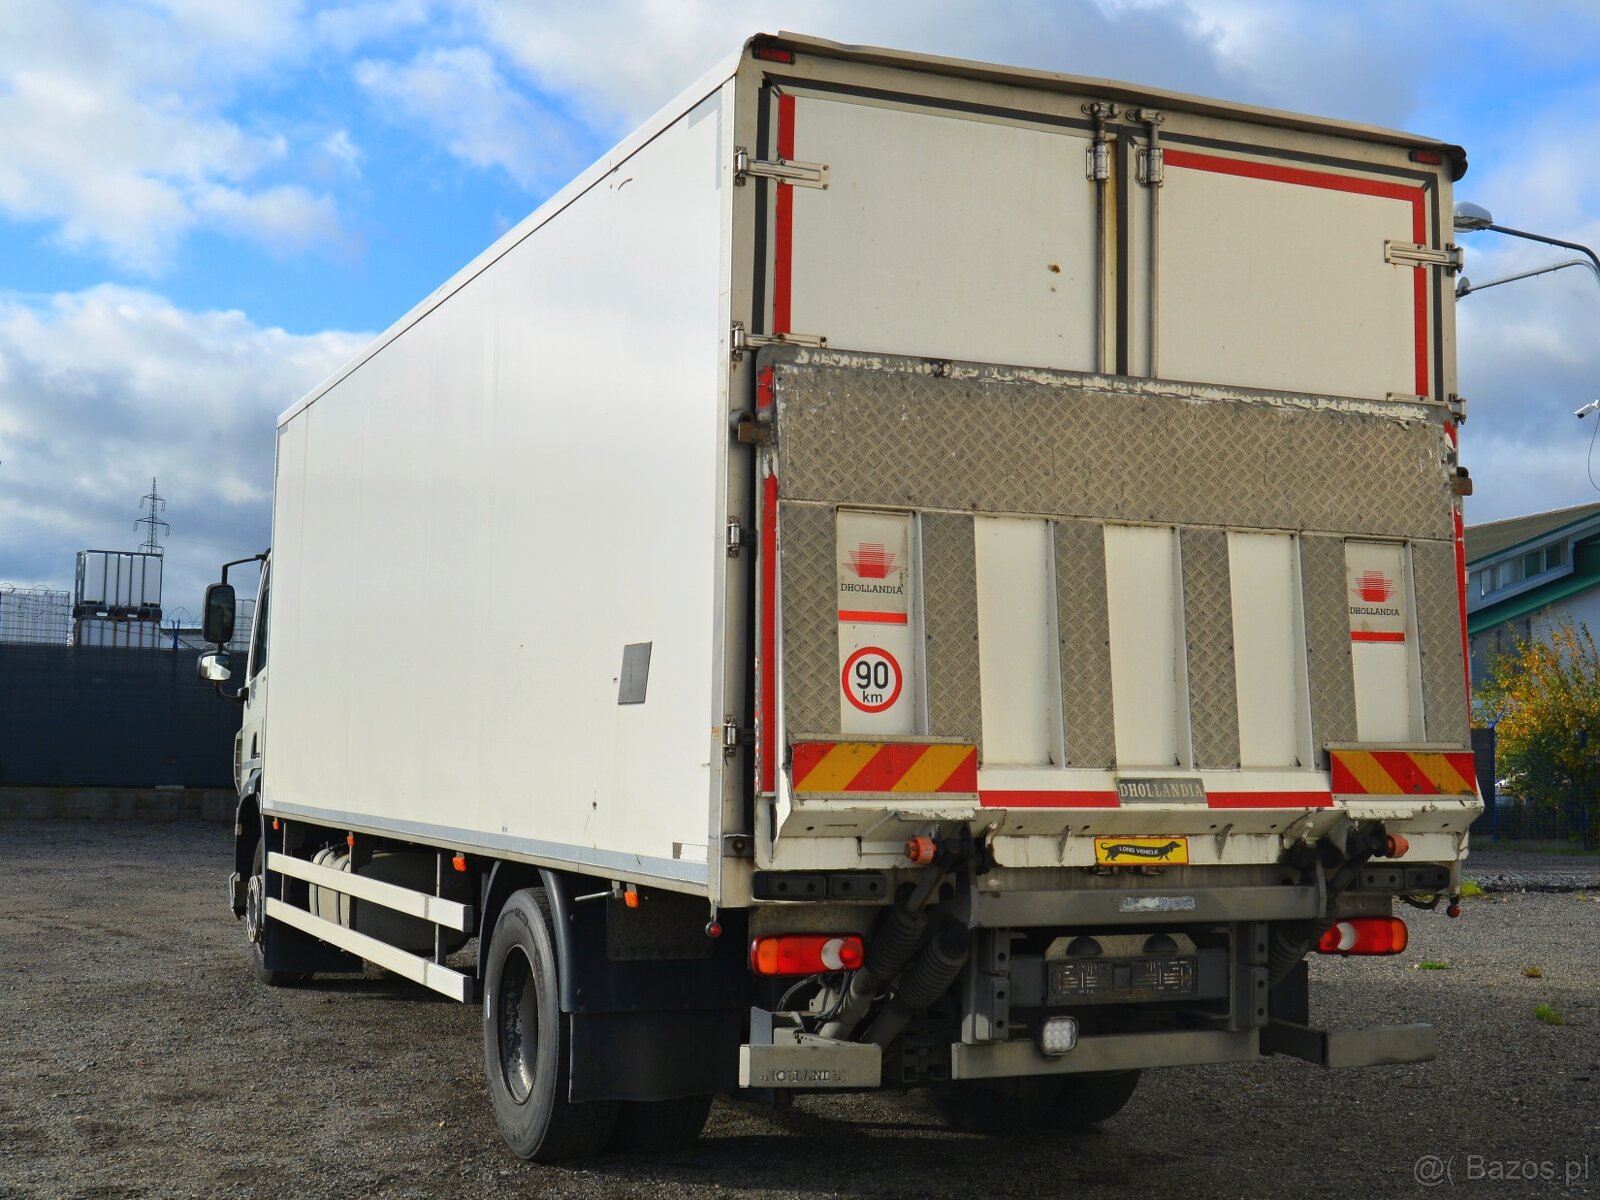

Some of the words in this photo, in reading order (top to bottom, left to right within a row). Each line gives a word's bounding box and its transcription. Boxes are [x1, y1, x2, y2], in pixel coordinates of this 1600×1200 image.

[840, 583, 903, 595] DHOLLANDIA
[1349, 606, 1400, 617] DHOLLANDIA
[855, 660, 889, 690] 90
[862, 690, 883, 703] km
[1119, 783, 1204, 798] DHOLLANDIA
[1118, 846, 1136, 854] LONG
[1136, 847, 1159, 855] VEHICLE
